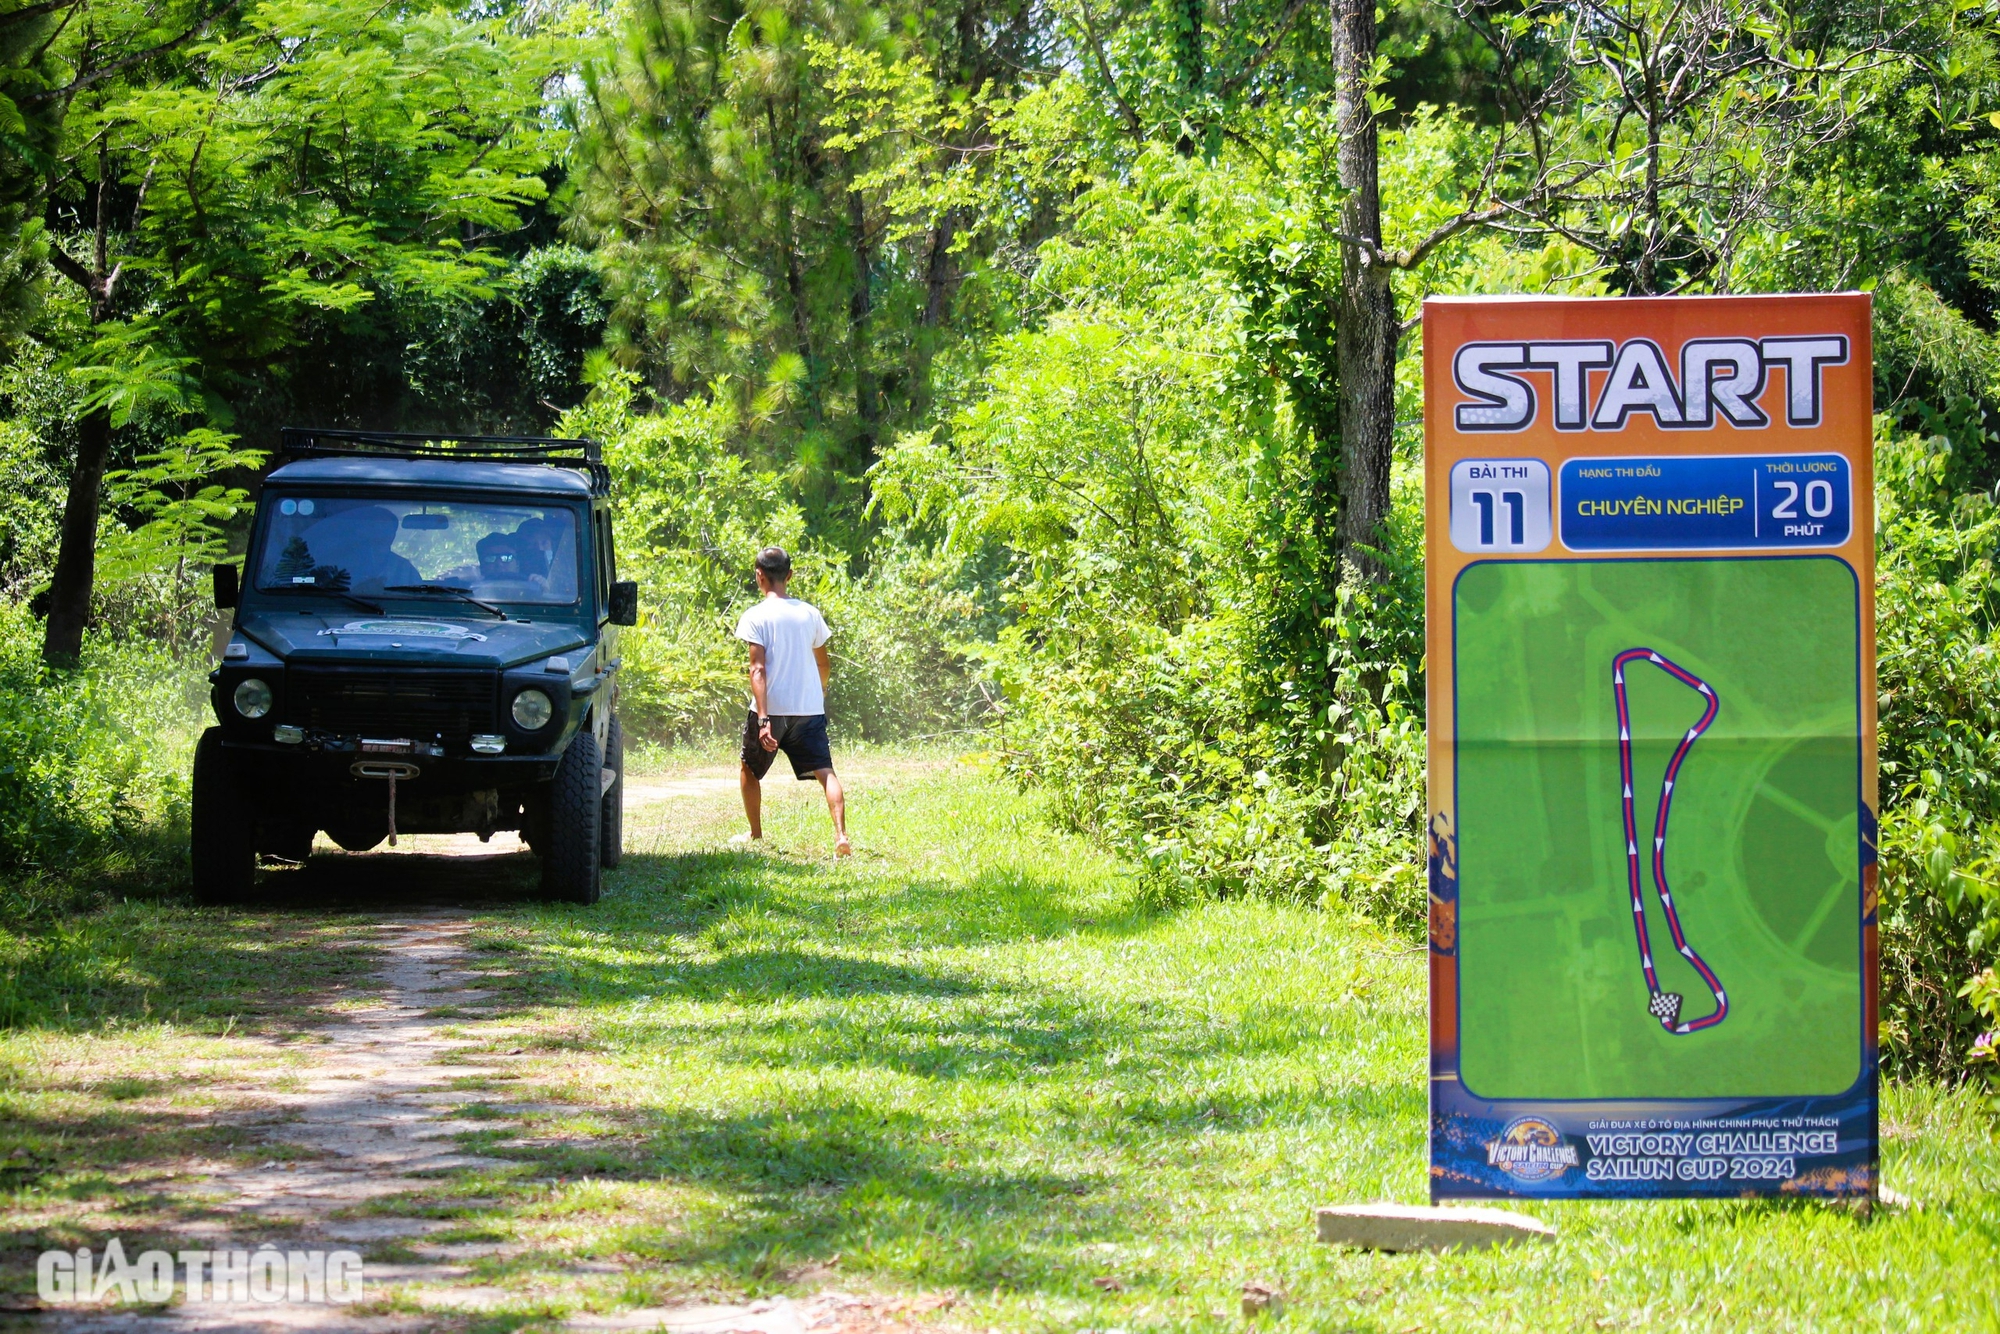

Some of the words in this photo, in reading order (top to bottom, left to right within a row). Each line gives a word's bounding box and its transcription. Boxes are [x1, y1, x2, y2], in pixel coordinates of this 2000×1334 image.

[1453, 336, 1849, 433] START
[1469, 464, 1496, 478] BÀI
[1501, 467, 1528, 478] THI
[1579, 468, 1613, 479] HẠNG
[1615, 467, 1634, 477] THI
[1636, 464, 1661, 477] ĐẤU
[1766, 462, 1794, 473] THỜI
[1796, 462, 1837, 473] LƯỢNG
[1577, 495, 1662, 516] CHUYÊN
[1666, 494, 1744, 516] NGHIỆP
[1772, 480, 1833, 519] 20
[1470, 490, 1525, 546] 11
[1784, 522, 1824, 537] PHÚT
[1589, 1119, 1608, 1129] GIẢI
[1611, 1121, 1632, 1129] ĐUA
[1634, 1121, 1647, 1129] XE
[1648, 1119, 1656, 1129] Ô
[1658, 1119, 1672, 1129] TÔ
[1673, 1121, 1690, 1130] ĐỊA
[1692, 1118, 1717, 1129] HÌNH
[1719, 1120, 1750, 1128] CHINH
[1752, 1120, 1780, 1129] PHỤC
[1782, 1117, 1804, 1127] THỬ
[1805, 1117, 1839, 1127] THÁCH
[1586, 1134, 1694, 1156] VICTORY
[1696, 1132, 1837, 1155] CHALLENGE
[1586, 1158, 1673, 1180] SAILUN
[1676, 1158, 1728, 1180] CUP
[1729, 1157, 1796, 1179] 2024
